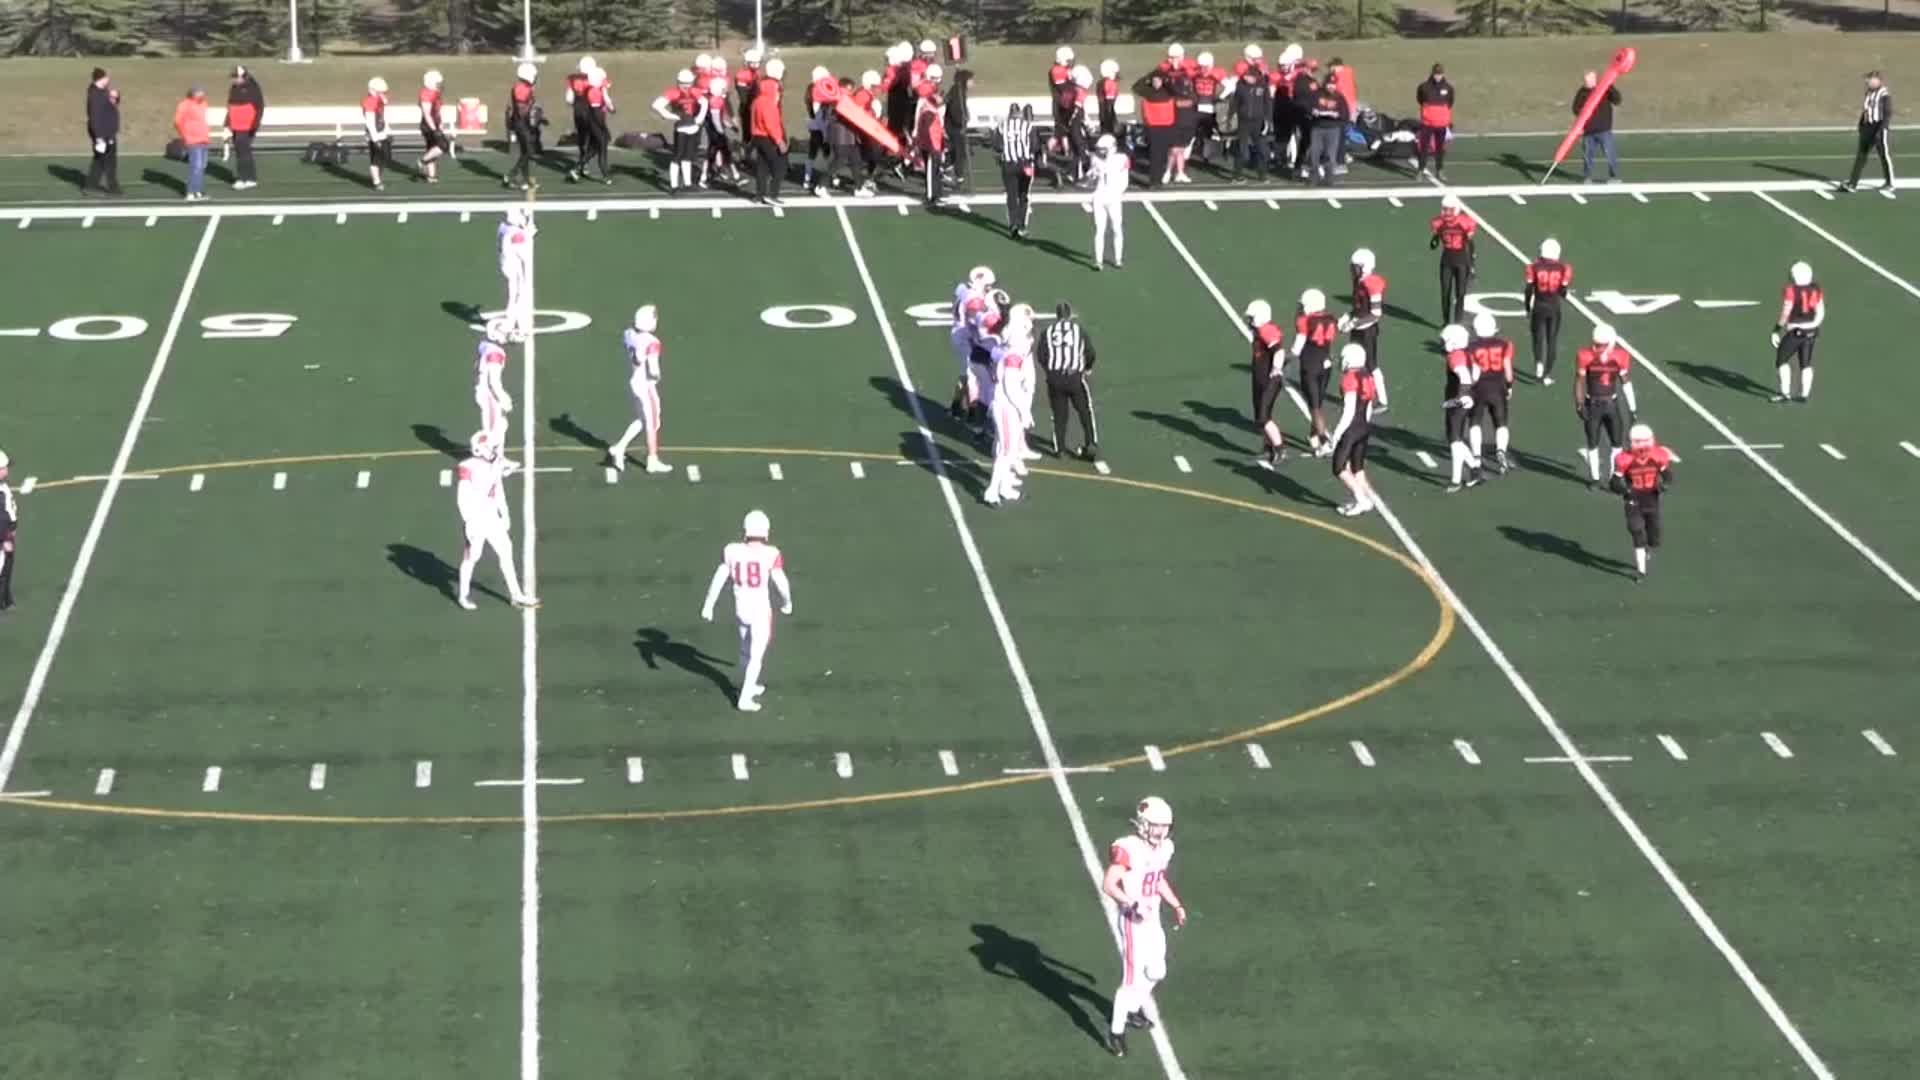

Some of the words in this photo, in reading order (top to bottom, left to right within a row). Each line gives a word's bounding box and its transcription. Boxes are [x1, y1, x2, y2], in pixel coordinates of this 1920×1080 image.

[949, 37, 961, 60] 1
[1052, 330, 1073, 347] 34
[1312, 322, 1336, 347] 44
[1475, 347, 1503, 371] 35
[735, 561, 761, 587] 18
